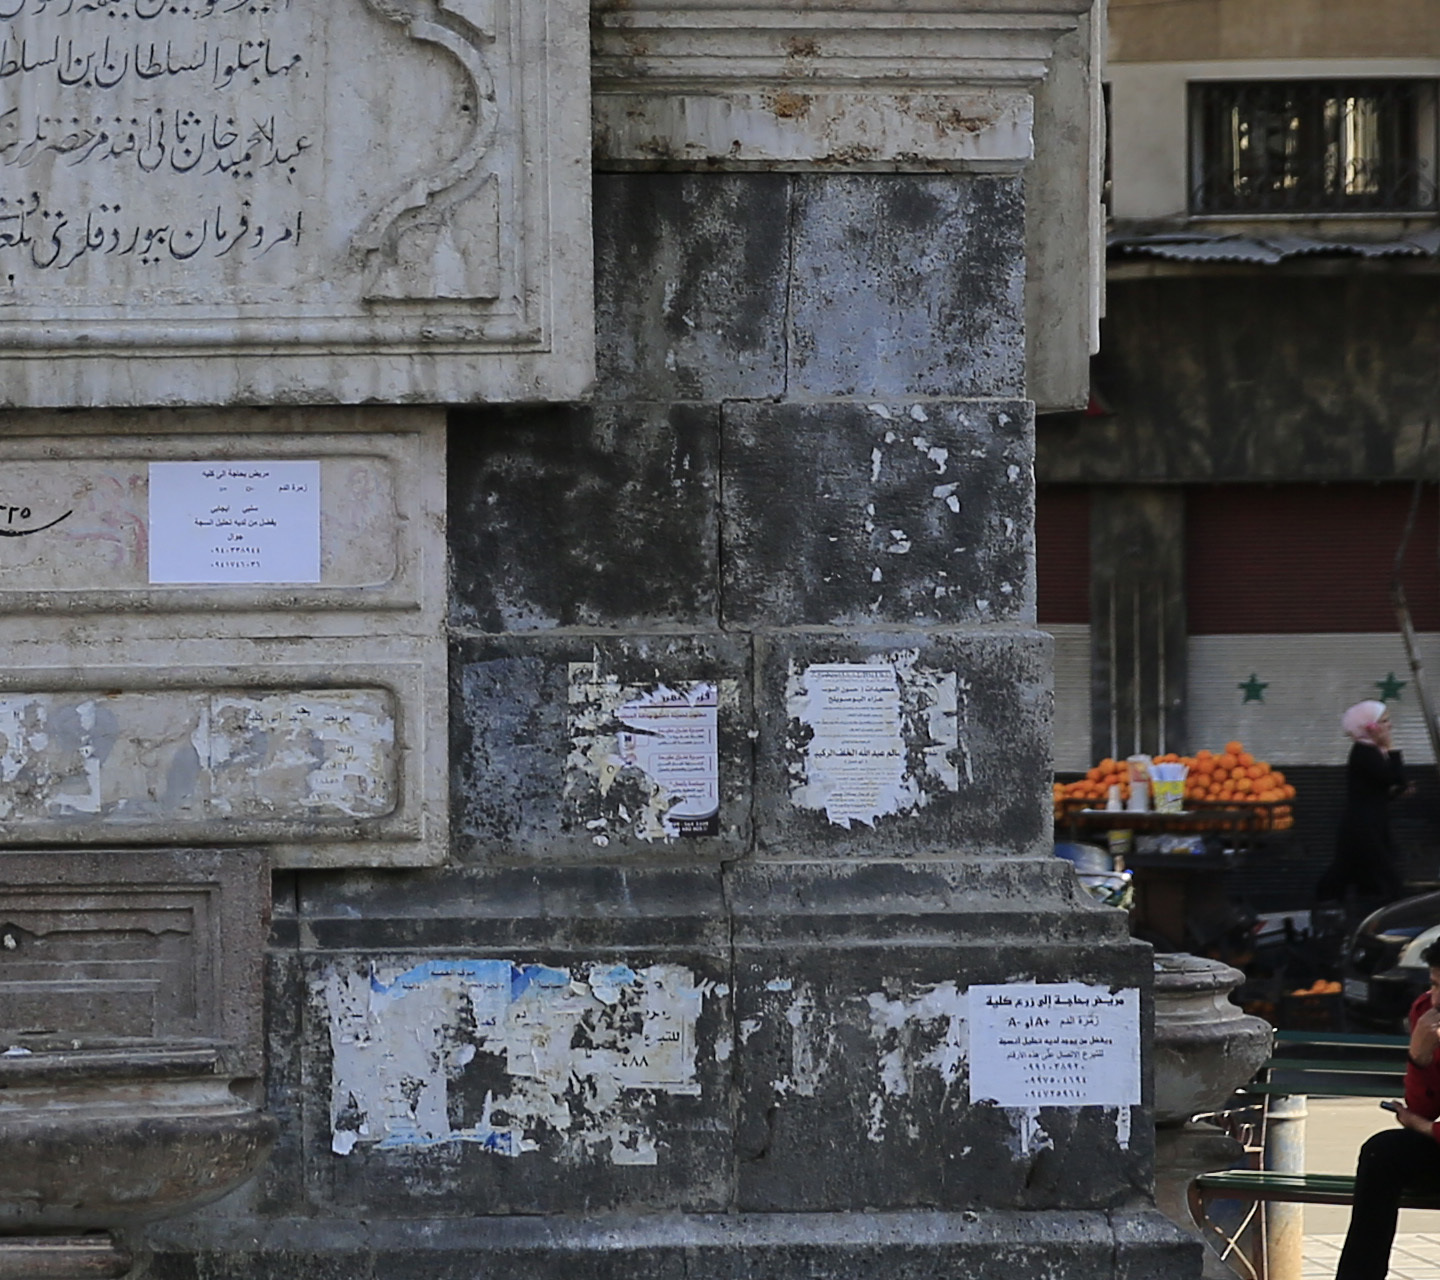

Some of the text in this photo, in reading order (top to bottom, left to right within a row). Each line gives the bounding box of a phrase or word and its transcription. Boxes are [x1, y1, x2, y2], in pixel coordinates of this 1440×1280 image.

[58, 36, 109, 86] ابن
[95, 38, 220, 89] السلطان
[170, 200, 251, 260] فرمان
[228, 469, 247, 478] بحاجة
[248, 470, 269, 478] مريض
[279, 483, 307, 492] زمرة الدم
[259, 518, 276, 527] يفضل
[227, 533, 243, 541] جوال
[986, 995, 1012, 1008] كلية
[1037, 995, 1052, 1008] إلى
[1055, 995, 1089, 1007] بحاجة
[1093, 995, 1124, 1006] مريض
[1060, 1016, 1075, 1027] الدم
[1079, 1015, 1099, 1026] زمرة
[1044, 1036, 1059, 1045] لديه
[1062, 1037, 1077, 1045] يوجد
[1079, 1037, 1088, 1045] من
[1090, 1036, 1113, 1045] ويفضل
